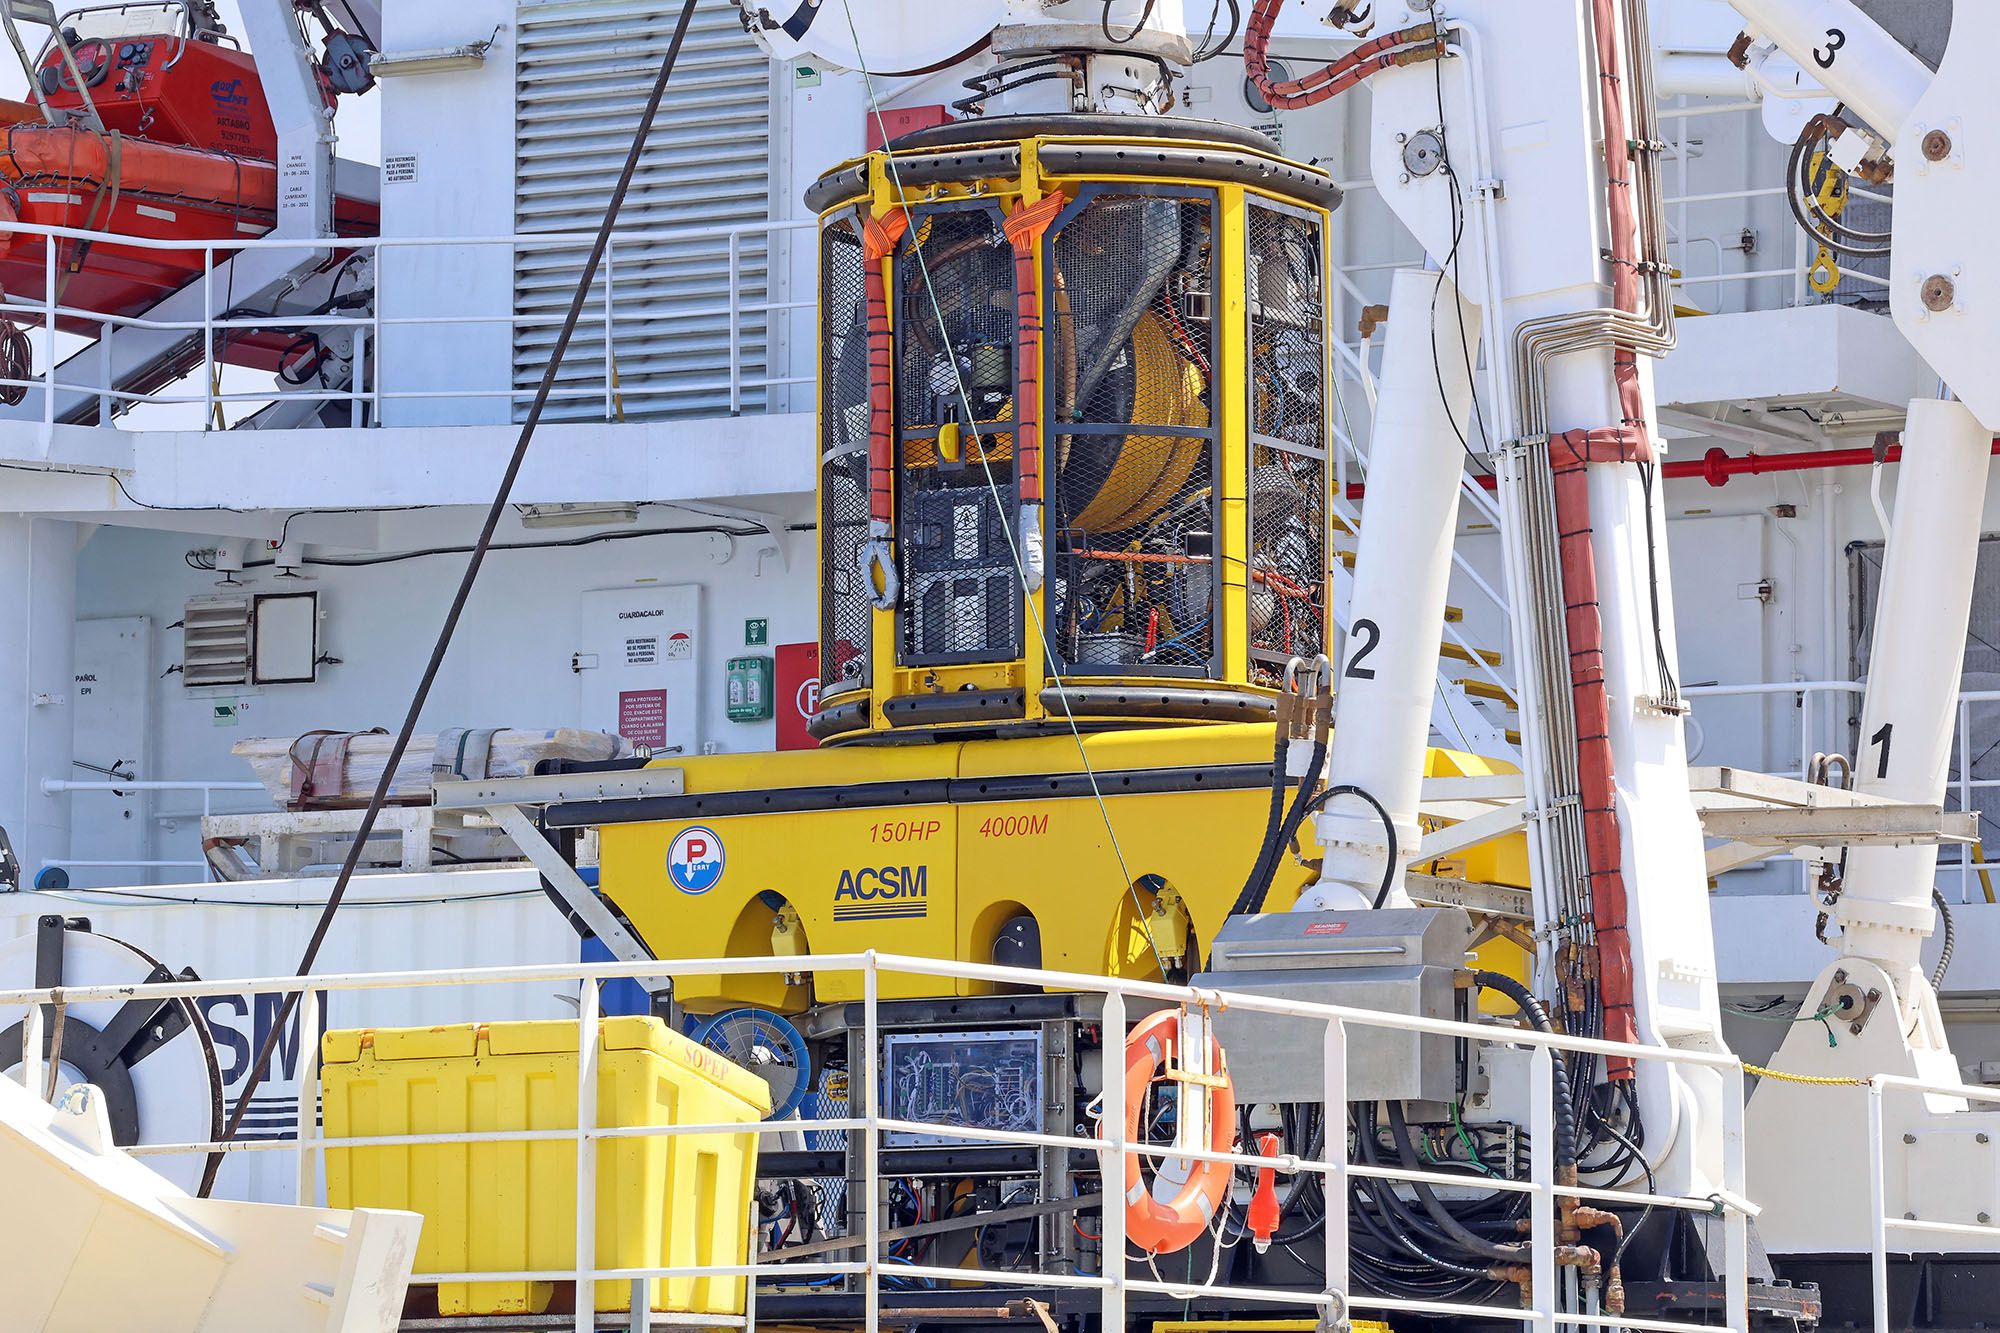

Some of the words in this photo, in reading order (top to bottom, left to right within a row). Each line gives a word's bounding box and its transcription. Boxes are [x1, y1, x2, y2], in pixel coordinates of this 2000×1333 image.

[1813, 28, 1845, 69] 3
[619, 610, 664, 619] GUARDACALOR
[1345, 618, 1380, 680] 2
[75, 674, 97, 682] PAÑOL
[1871, 723, 1893, 778] 1
[870, 820, 941, 843] 150HP
[980, 814, 1048, 837] 4000M
[834, 865, 927, 900] ACSM
[683, 1044, 729, 1081] SOPEP
